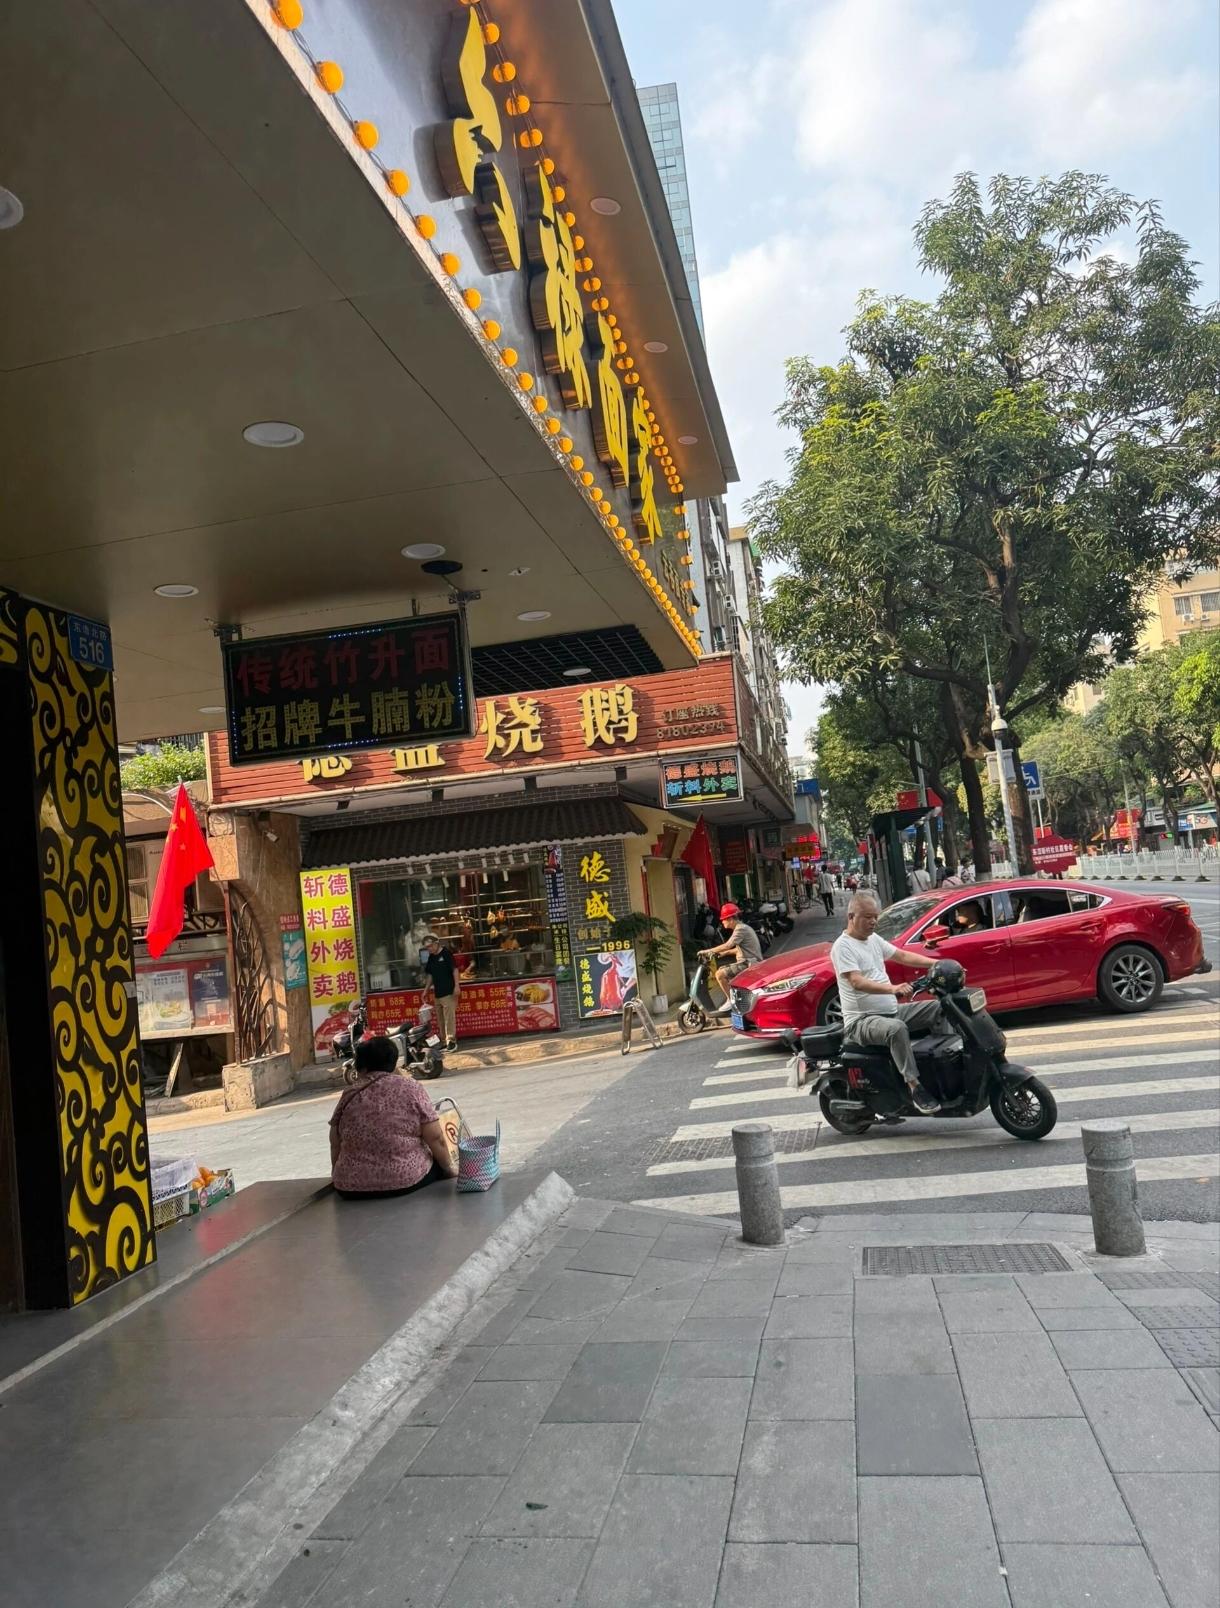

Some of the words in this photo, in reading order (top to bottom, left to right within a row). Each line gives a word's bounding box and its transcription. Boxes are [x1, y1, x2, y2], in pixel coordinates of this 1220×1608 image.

[79, 637, 105, 664] 516
[237, 627, 450, 697] 传统竹升面
[240, 680, 456, 751] 招牌牛腩粉
[580, 850, 617, 923] 德盛
[303, 874, 334, 999] 斩料外卖
[327, 872, 358, 995] 德盛烧鹅
[601, 940, 631, 953] 1996
